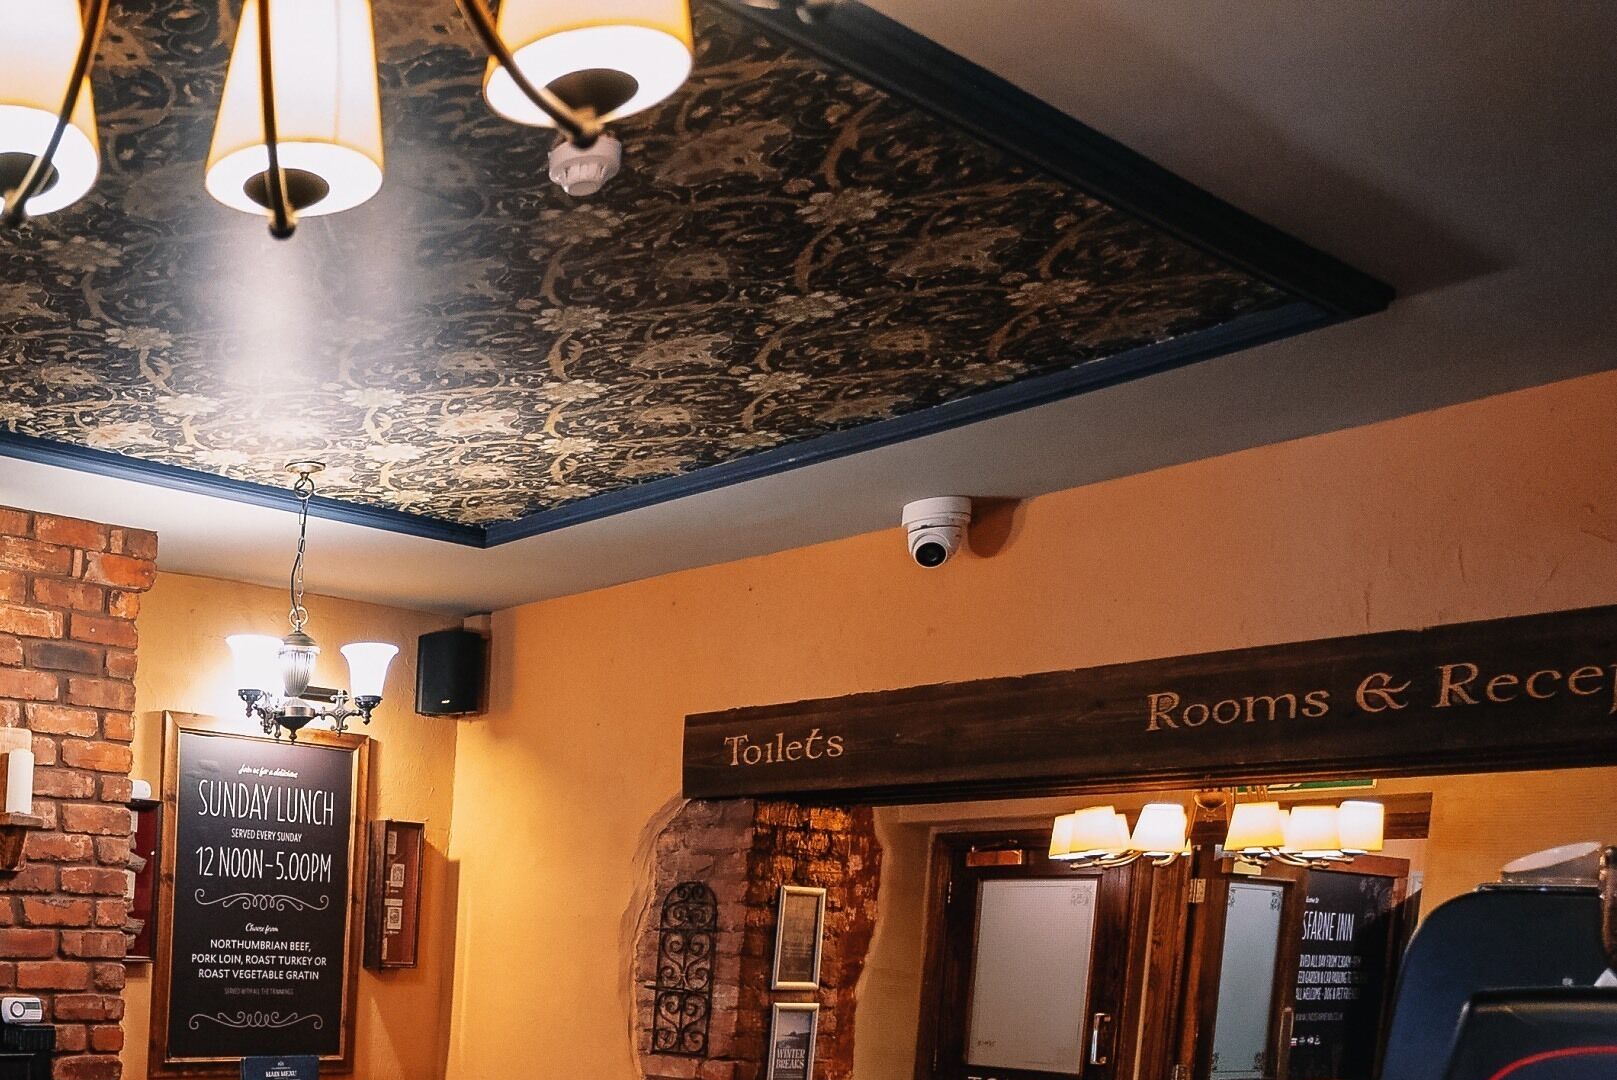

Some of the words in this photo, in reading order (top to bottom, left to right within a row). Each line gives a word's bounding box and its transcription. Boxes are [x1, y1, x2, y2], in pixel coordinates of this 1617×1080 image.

[1146, 688, 1330, 732] Rooms
[1356, 671, 1412, 713] &
[724, 728, 844, 767] Toilets
[198, 779, 273, 821] SUNDAY
[277, 786, 334, 827] LUNCH
[231, 828, 256, 840] SERVED
[256, 830, 276, 841] EVERY
[277, 832, 302, 843] SUNDAY
[195, 846, 214, 876] 12
[245, 922, 264, 933] Choose
[264, 923, 279, 935] from
[1336, 912, 1355, 942] INN
[210, 939, 288, 951] NORTHUMBRIAN
[289, 941, 312, 952] BEEF,
[191, 953, 217, 964] PORK
[218, 954, 244, 966] LOIN,
[245, 955, 276, 966] ROAST
[278, 956, 313, 966] TURKEY
[314, 957, 327, 966] OR
[198, 968, 230, 979] ROAST
[232, 969, 284, 980] VEGETABLE
[285, 970, 319, 980] GRATIN
[777, 1048, 806, 1060] WINTER
[775, 1058, 805, 1070] BREAKS
